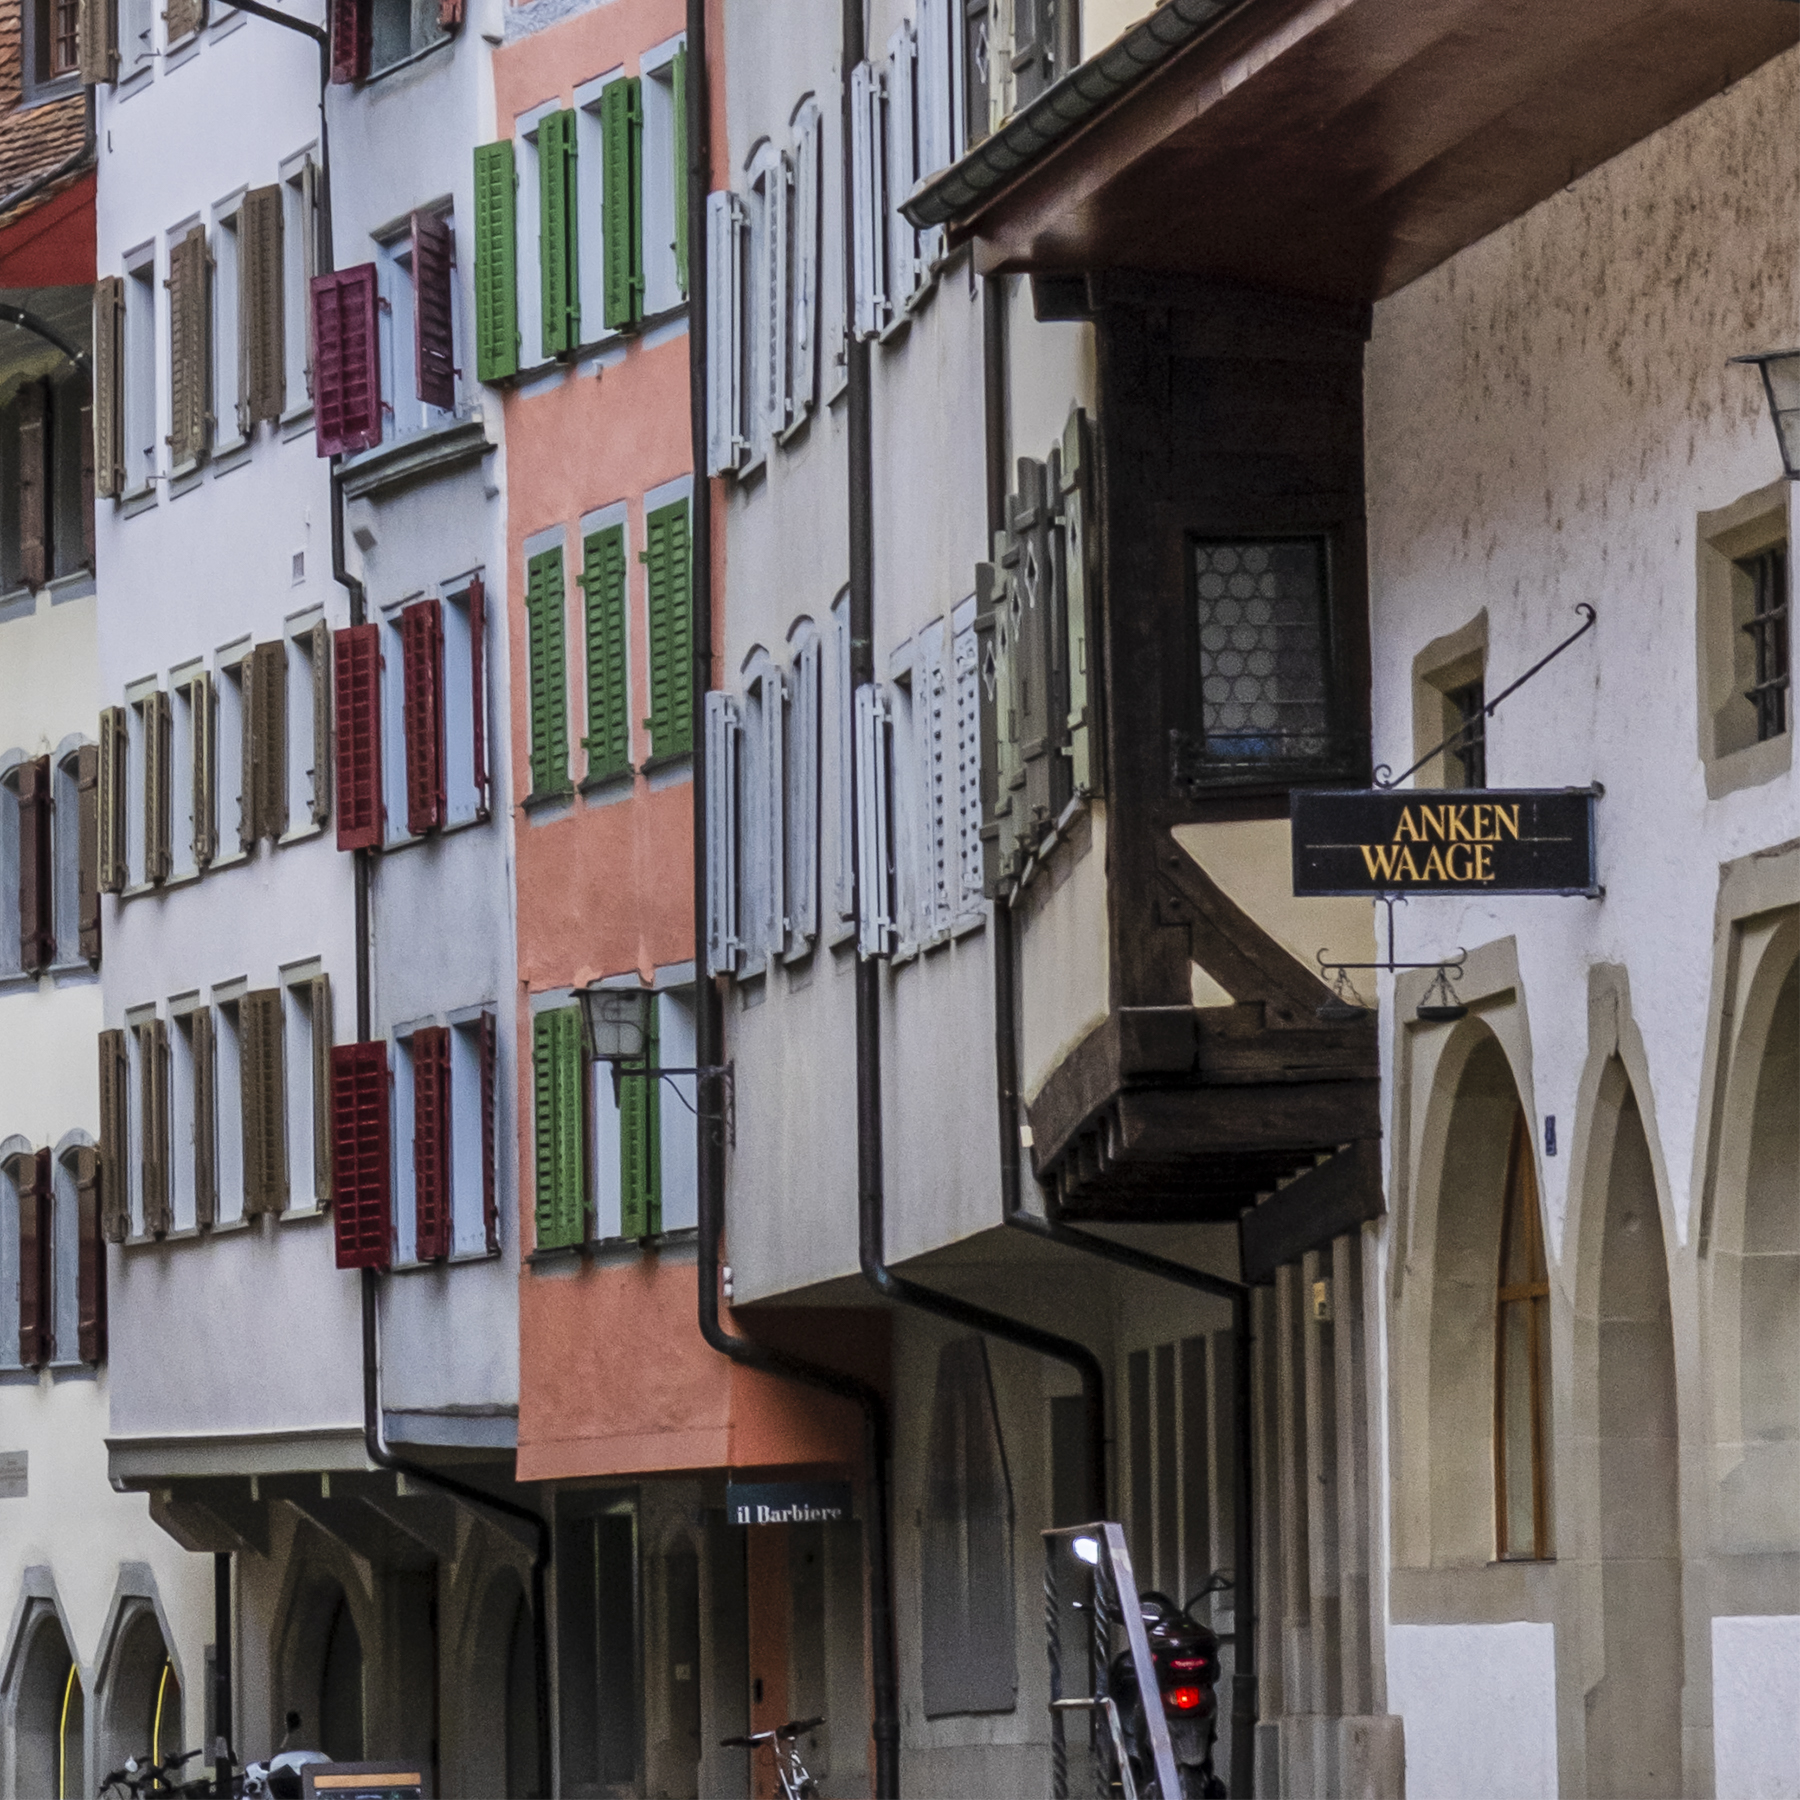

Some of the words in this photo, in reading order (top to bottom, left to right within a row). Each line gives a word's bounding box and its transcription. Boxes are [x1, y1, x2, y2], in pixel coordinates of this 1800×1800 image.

[1392, 803, 1520, 842] ANKEN
[1360, 842, 1495, 881] WAAGE
[756, 1503, 842, 1525] Barbiere
